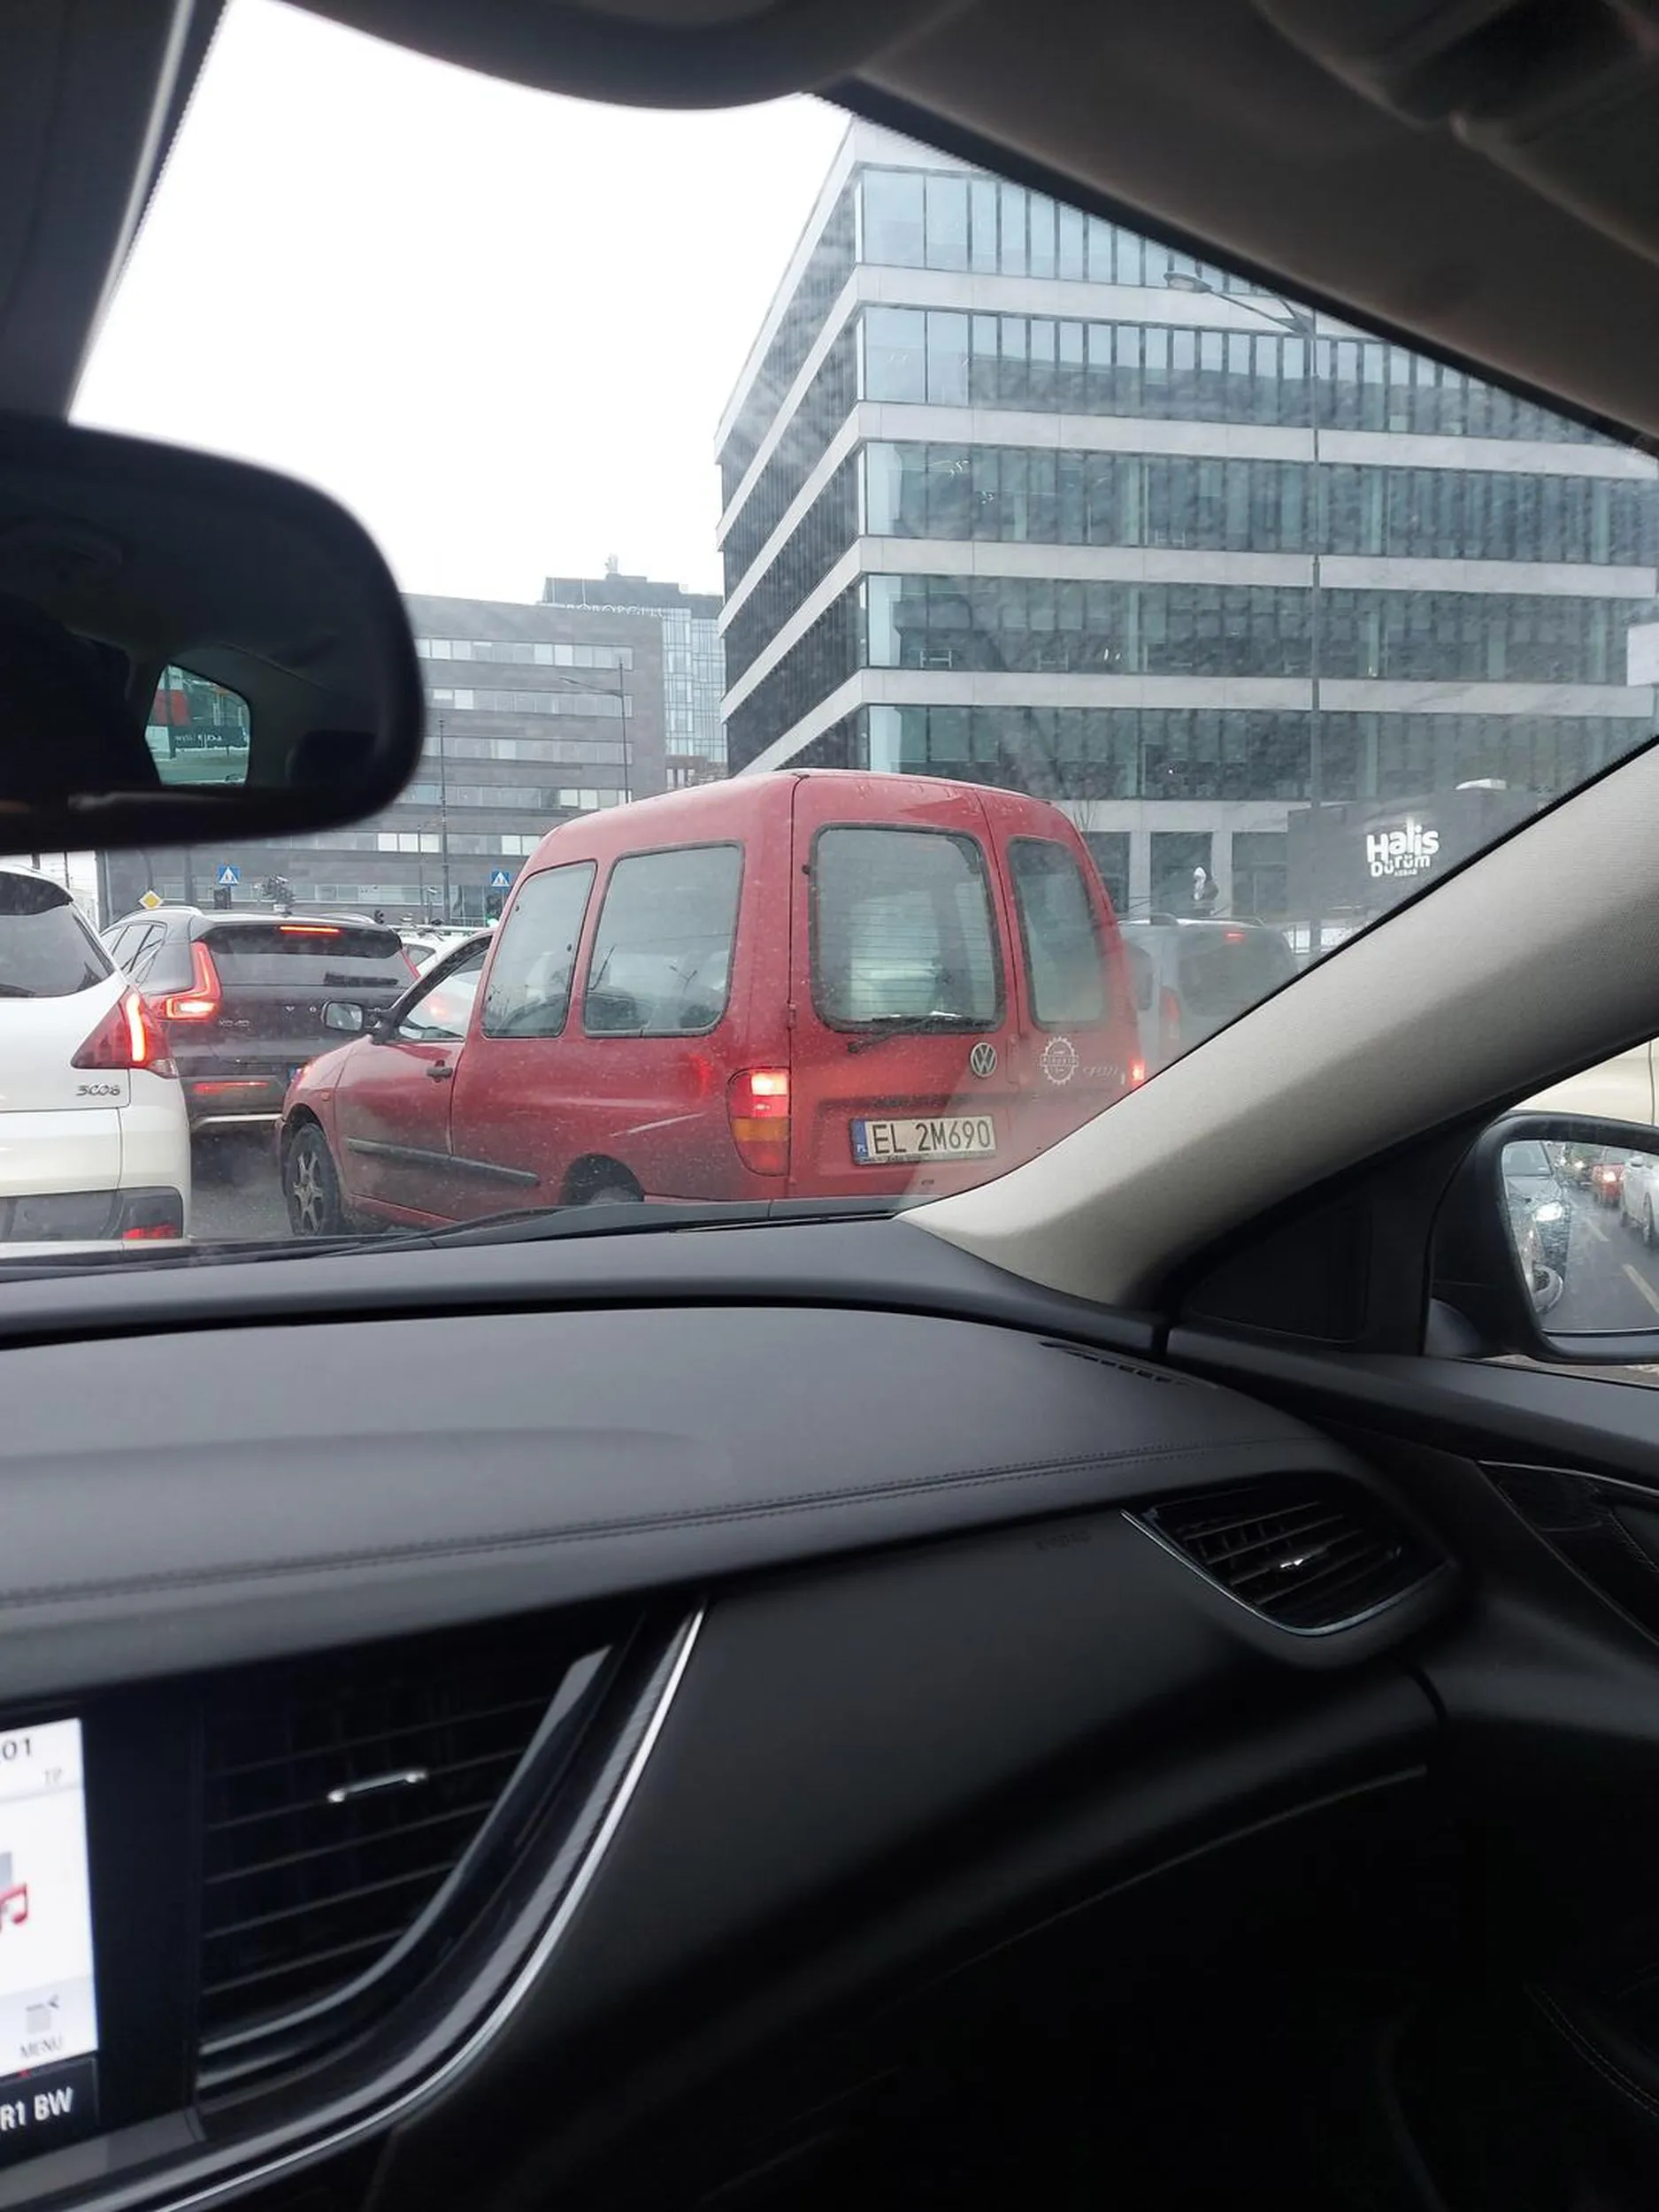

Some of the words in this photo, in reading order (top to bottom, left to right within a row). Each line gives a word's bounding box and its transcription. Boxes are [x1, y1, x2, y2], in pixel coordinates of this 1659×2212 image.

[1366, 816, 1440, 863] Halis
[872, 1123, 907, 1155] EL
[915, 1119, 991, 1152] 2M690
[19, 2035, 64, 2057] MENU
[34, 2086, 74, 2122] BW
